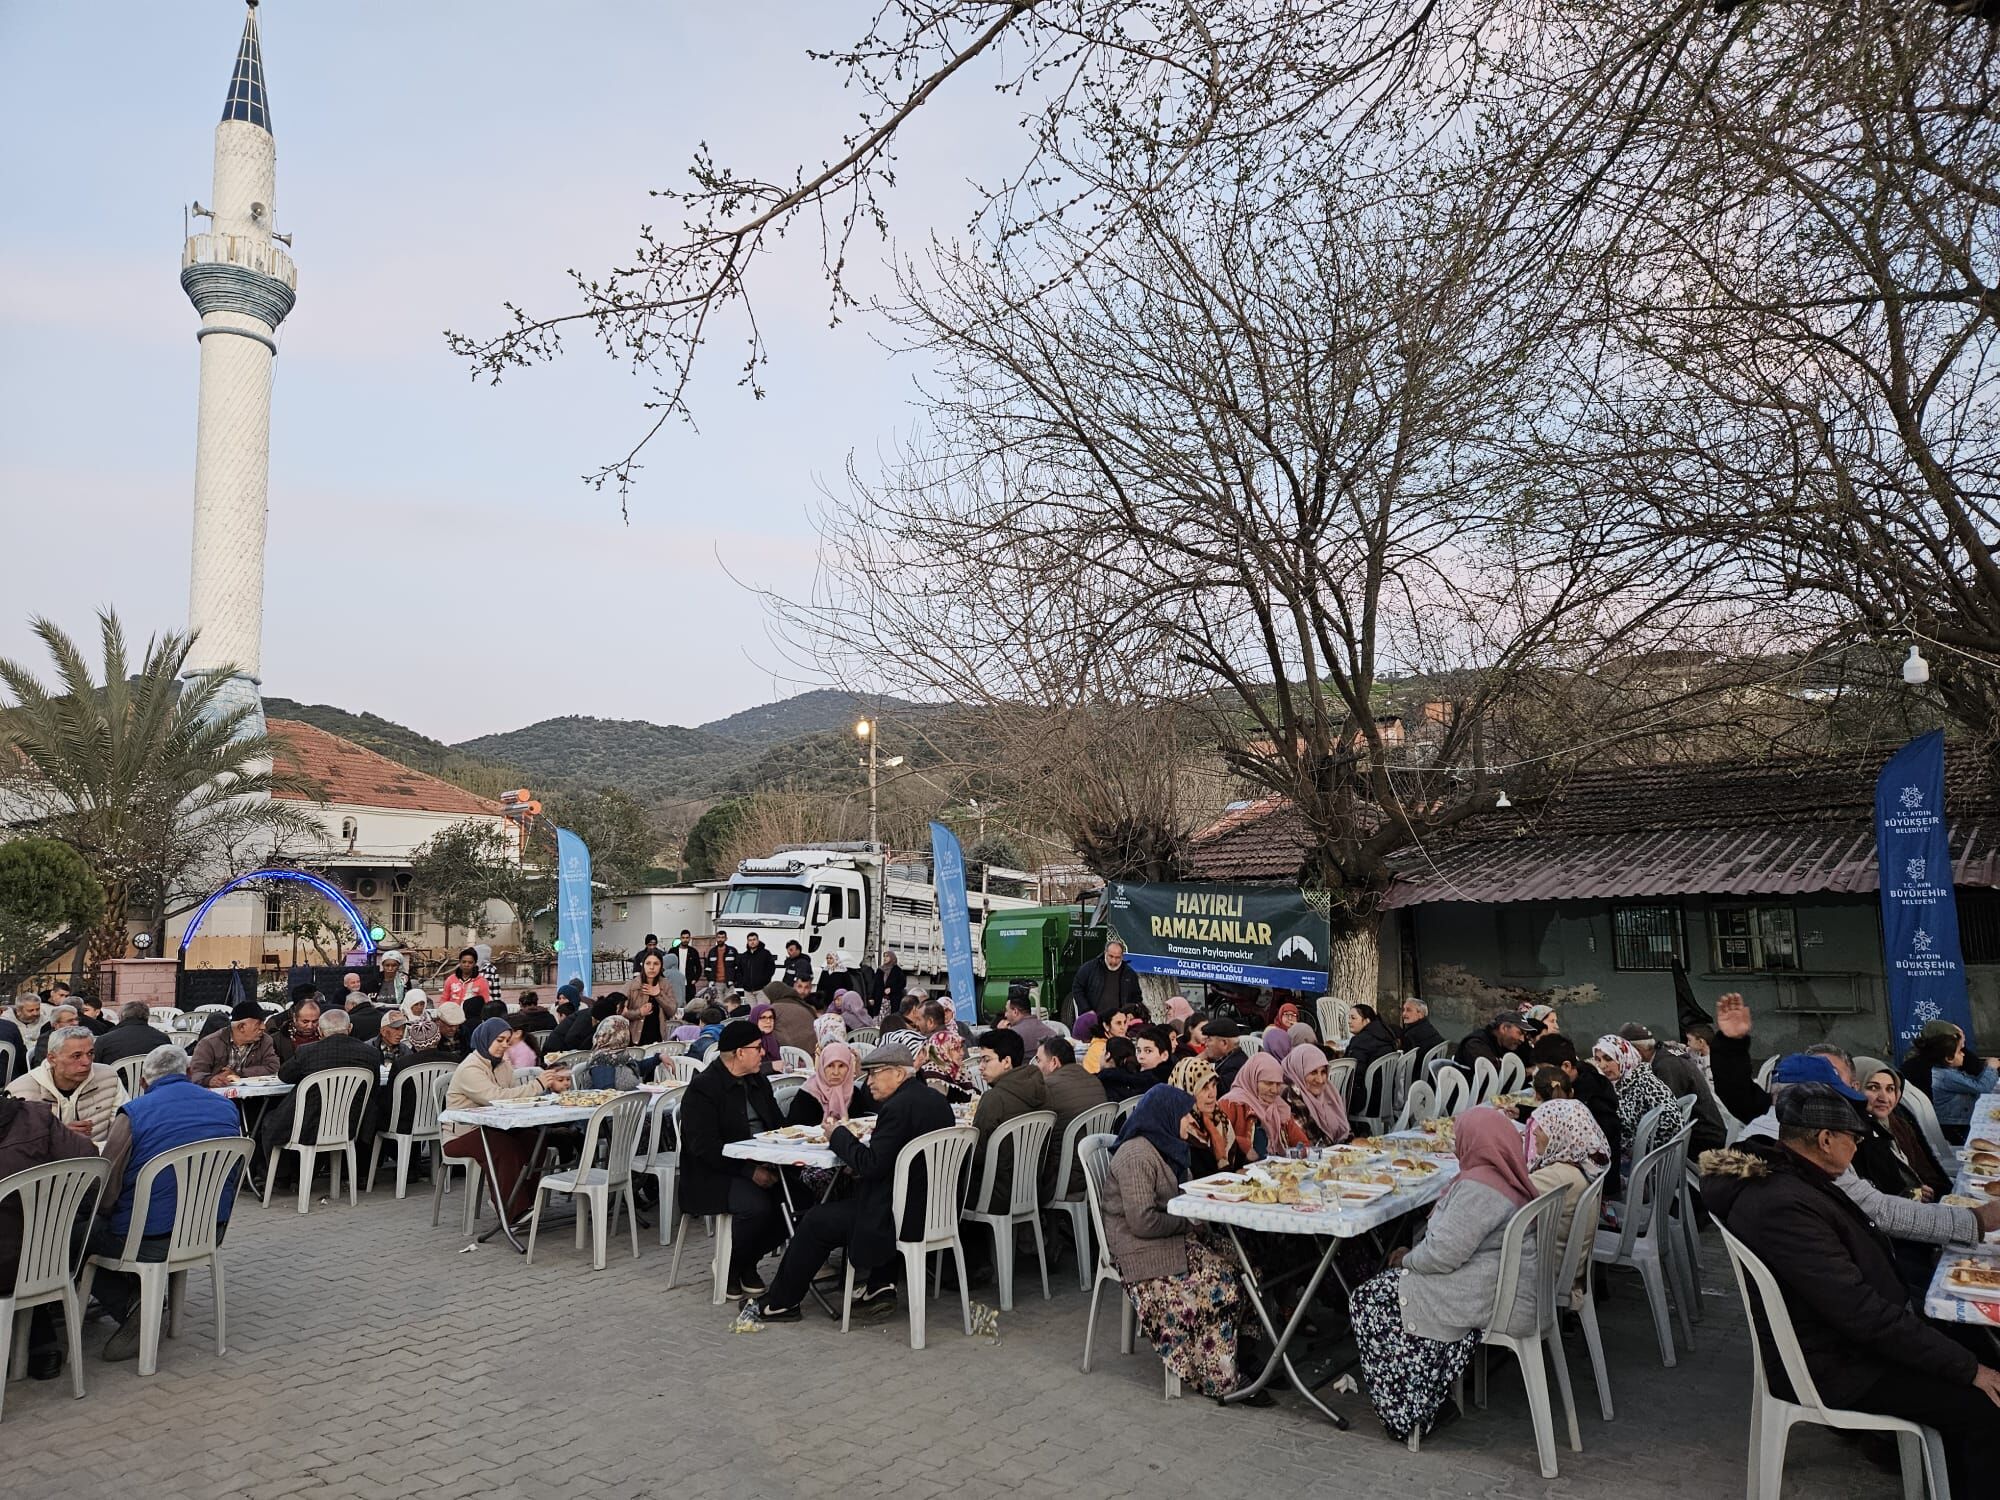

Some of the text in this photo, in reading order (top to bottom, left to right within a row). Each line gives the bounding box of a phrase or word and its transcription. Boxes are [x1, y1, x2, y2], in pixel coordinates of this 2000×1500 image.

[1175, 892, 1244, 917] HAYIRLI
[1151, 916, 1272, 946] RAMAZANLAR
[1168, 943, 1254, 960] Ramazan Paylaşmaktır
[1177, 960, 1201, 970] ÖZLEM
[1216, 972, 1242, 982] BELEDİYE
[1244, 976, 1269, 984] BAŞKANI
